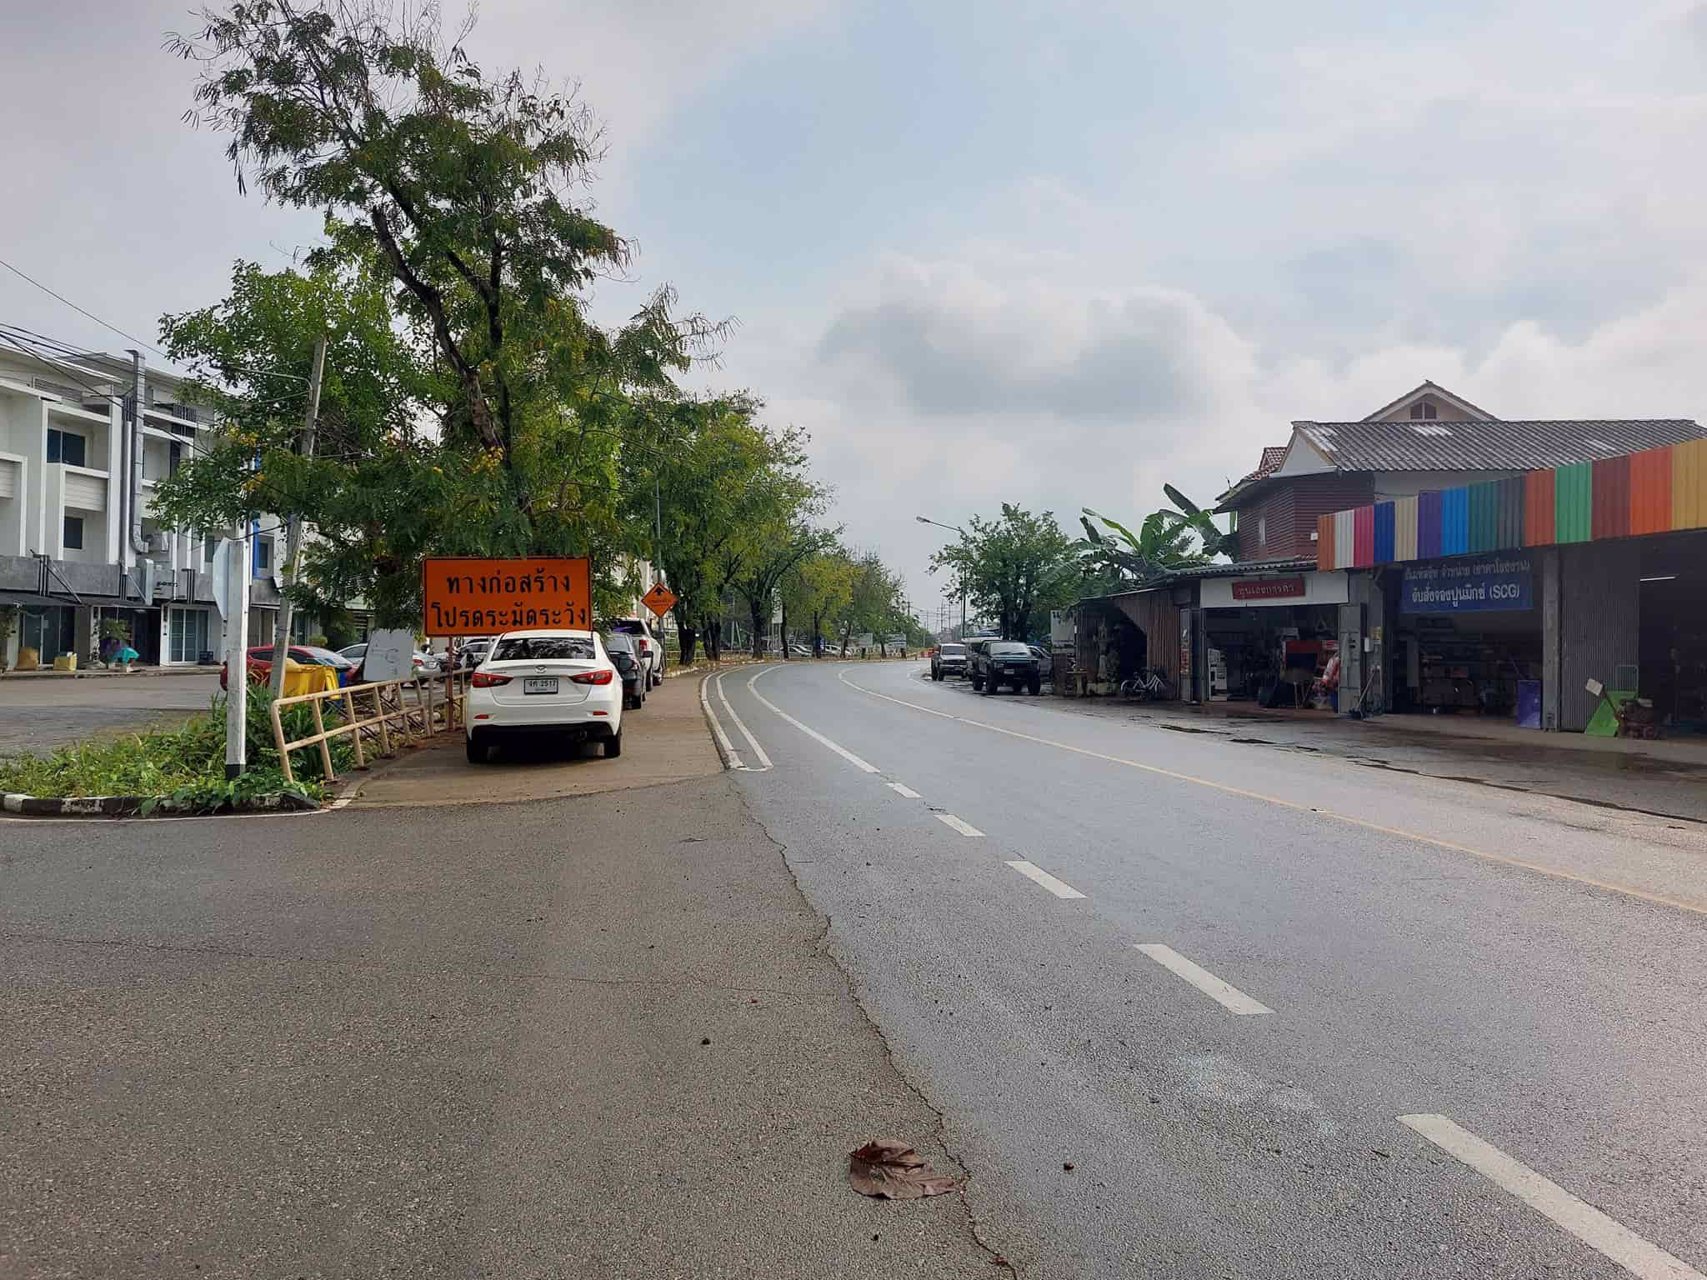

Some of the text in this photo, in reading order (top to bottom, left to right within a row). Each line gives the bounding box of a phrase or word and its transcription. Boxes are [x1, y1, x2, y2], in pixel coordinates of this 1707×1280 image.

[447, 567, 572, 595] ทางก่อสร้าง
[1489, 583, 1520, 601] (SCG)
[431, 602, 587, 628] โปรดระมัดระวัง
